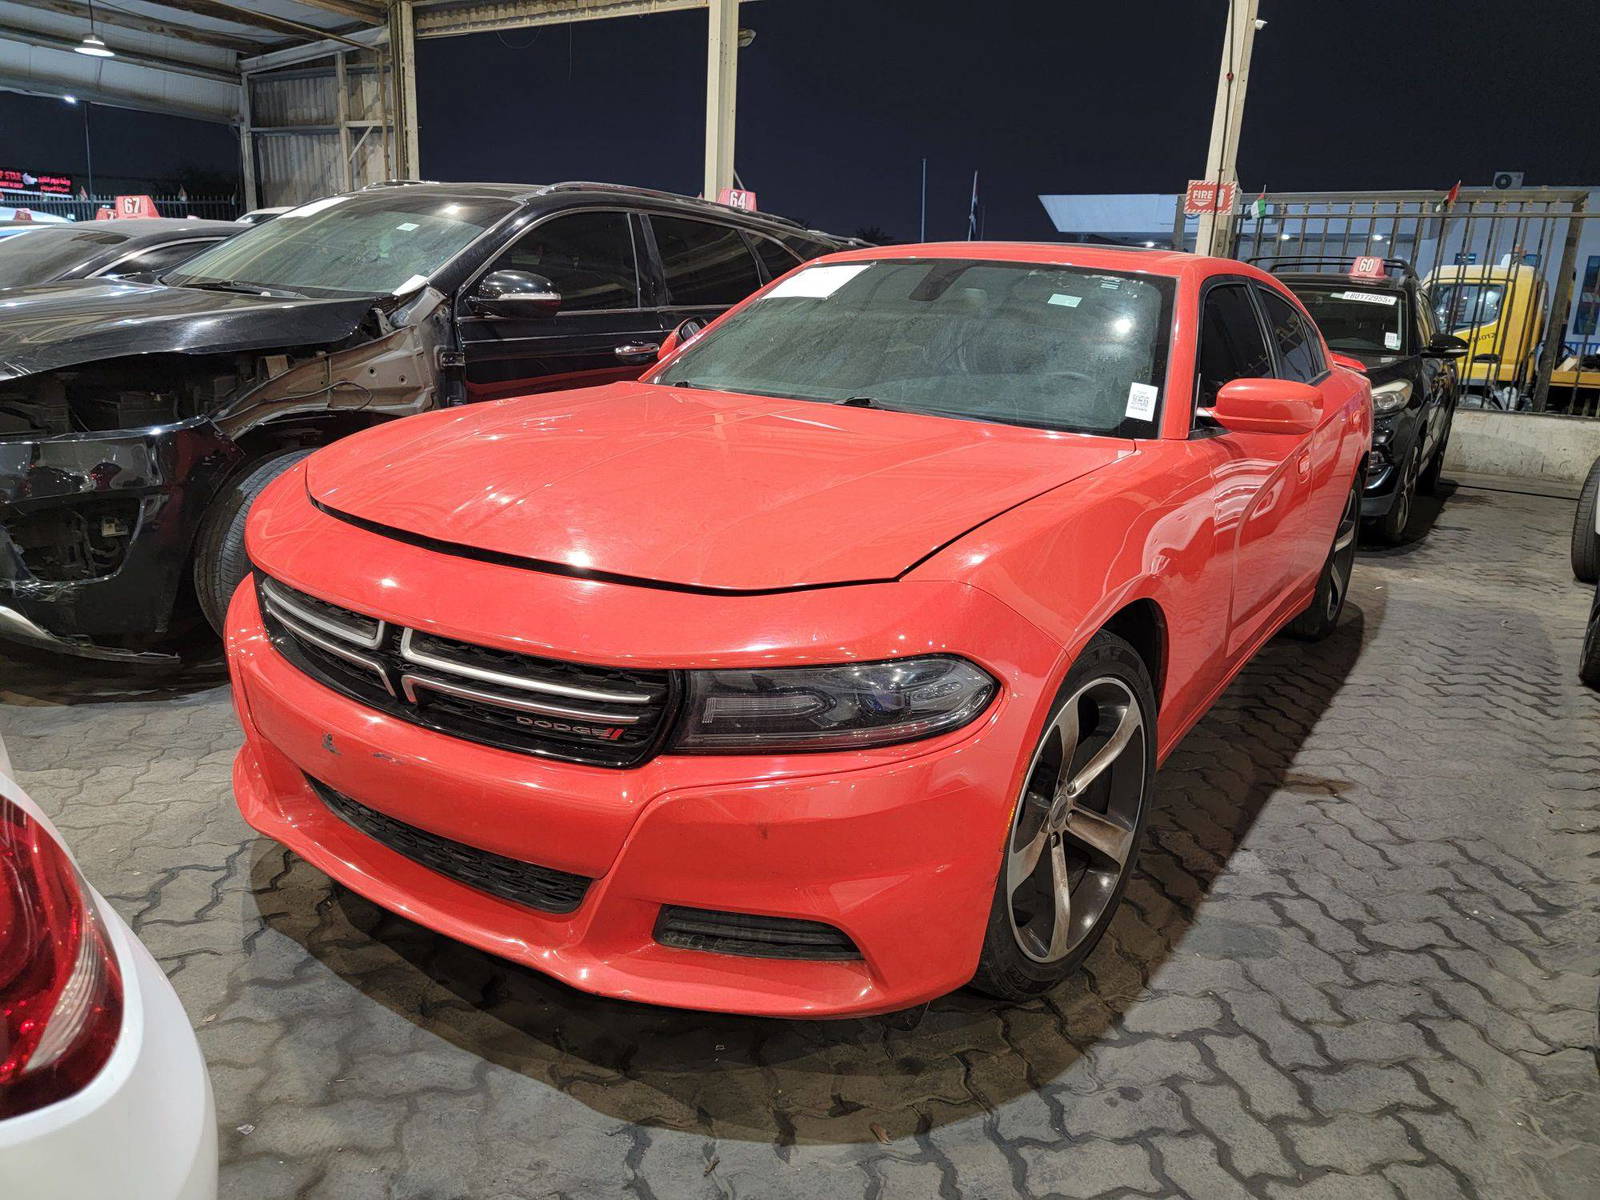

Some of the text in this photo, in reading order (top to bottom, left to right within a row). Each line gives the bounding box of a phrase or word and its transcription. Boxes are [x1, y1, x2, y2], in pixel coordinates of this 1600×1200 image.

[730, 191, 746, 209] 64
[1192, 190, 1214, 200] FIRE
[124, 198, 140, 214] 67
[1359, 258, 1374, 272] 60
[516, 716, 609, 737] DODGE
